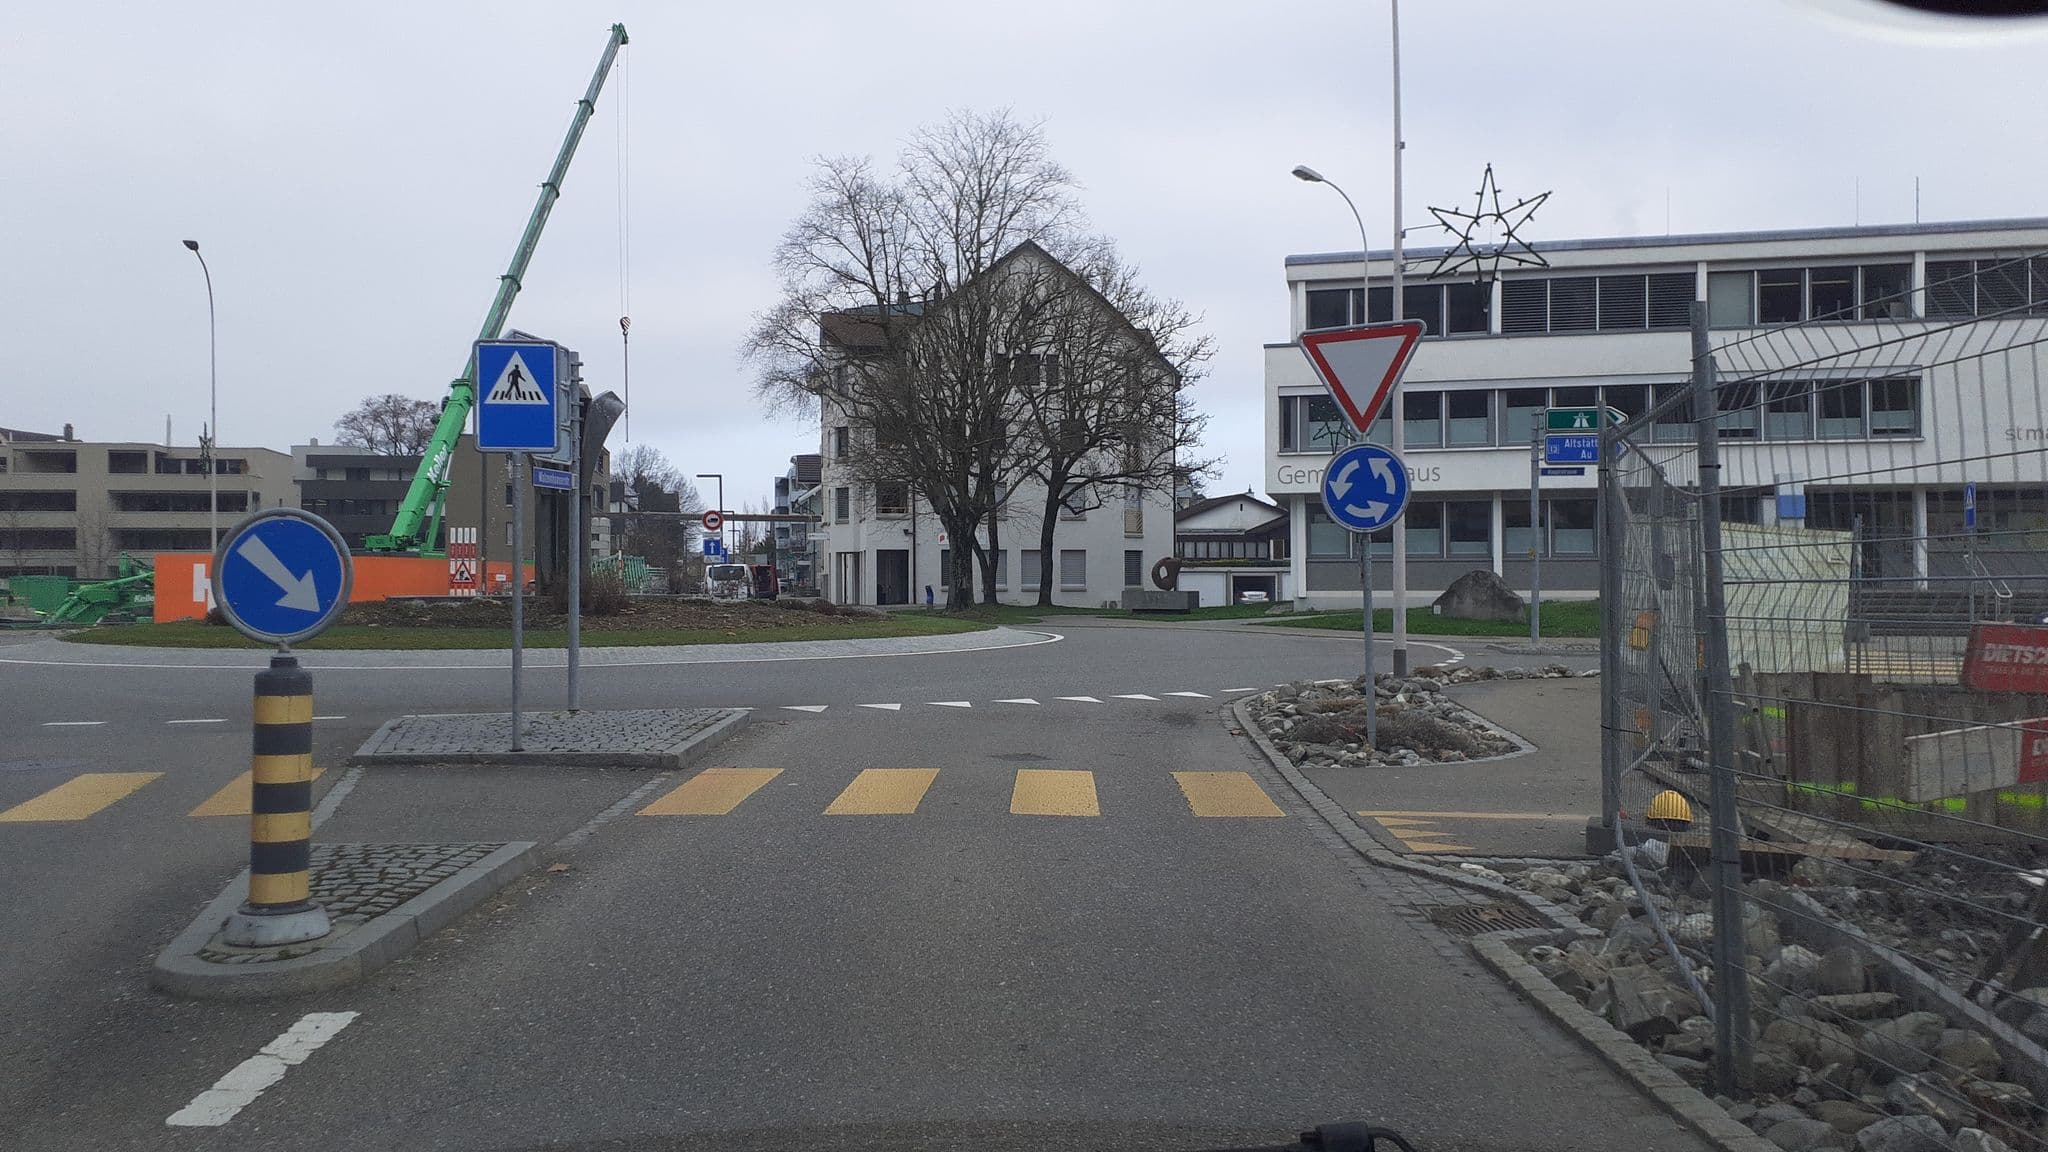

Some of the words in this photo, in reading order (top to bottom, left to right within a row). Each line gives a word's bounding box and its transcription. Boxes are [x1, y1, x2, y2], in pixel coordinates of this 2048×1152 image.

[1564, 437, 1599, 448] Altstätt
[1581, 450, 1592, 459] Au
[1277, 465, 1441, 485] Gemaus
